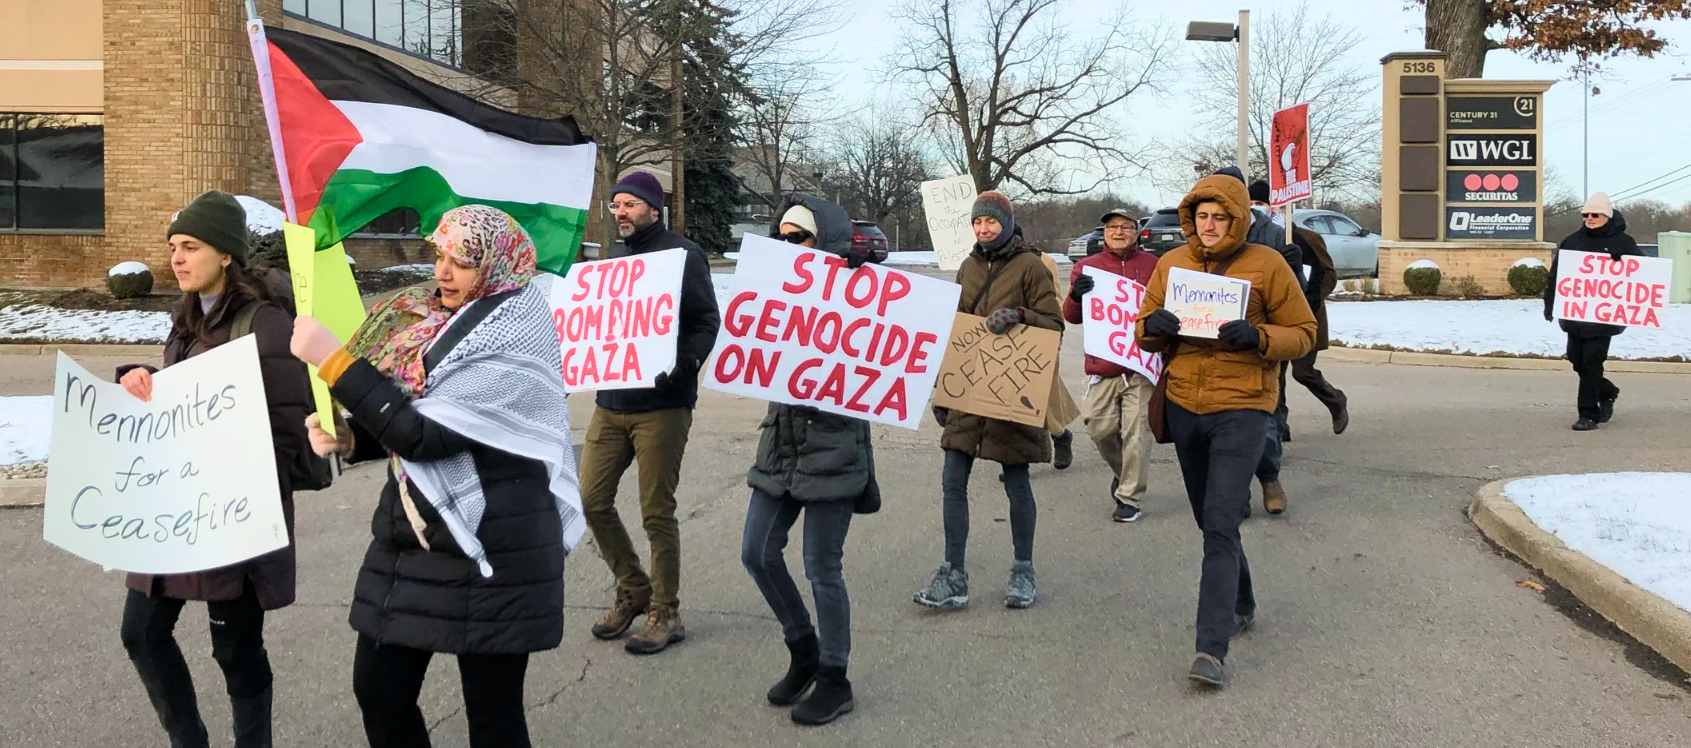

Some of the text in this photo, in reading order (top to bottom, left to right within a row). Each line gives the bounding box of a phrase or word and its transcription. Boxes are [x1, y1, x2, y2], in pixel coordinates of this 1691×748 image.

[1403, 62, 1435, 73] 5136
[1520, 99, 1533, 110] 21
[931, 181, 972, 204] END
[1270, 179, 1310, 204] PALESTINE
[1465, 191, 1519, 201] SECURITAS
[1470, 212, 1533, 223] LeaderOne
[571, 258, 645, 302] STOP
[1578, 254, 1640, 278] STOP
[782, 252, 912, 317] STOP
[1172, 282, 1238, 306] Mennonites
[1557, 277, 1666, 308] GENOCIDE
[1563, 301, 1660, 328] IN GAZA
[723, 290, 938, 374] GENOCIDE
[951, 322, 988, 353] NOW
[562, 341, 643, 387] GAZA
[987, 344, 1051, 405] FIRE
[714, 343, 908, 421] ON GAZA
[65, 371, 236, 444] Mennonites
[114, 455, 200, 493] for a
[71, 485, 252, 546] Ceasefire
